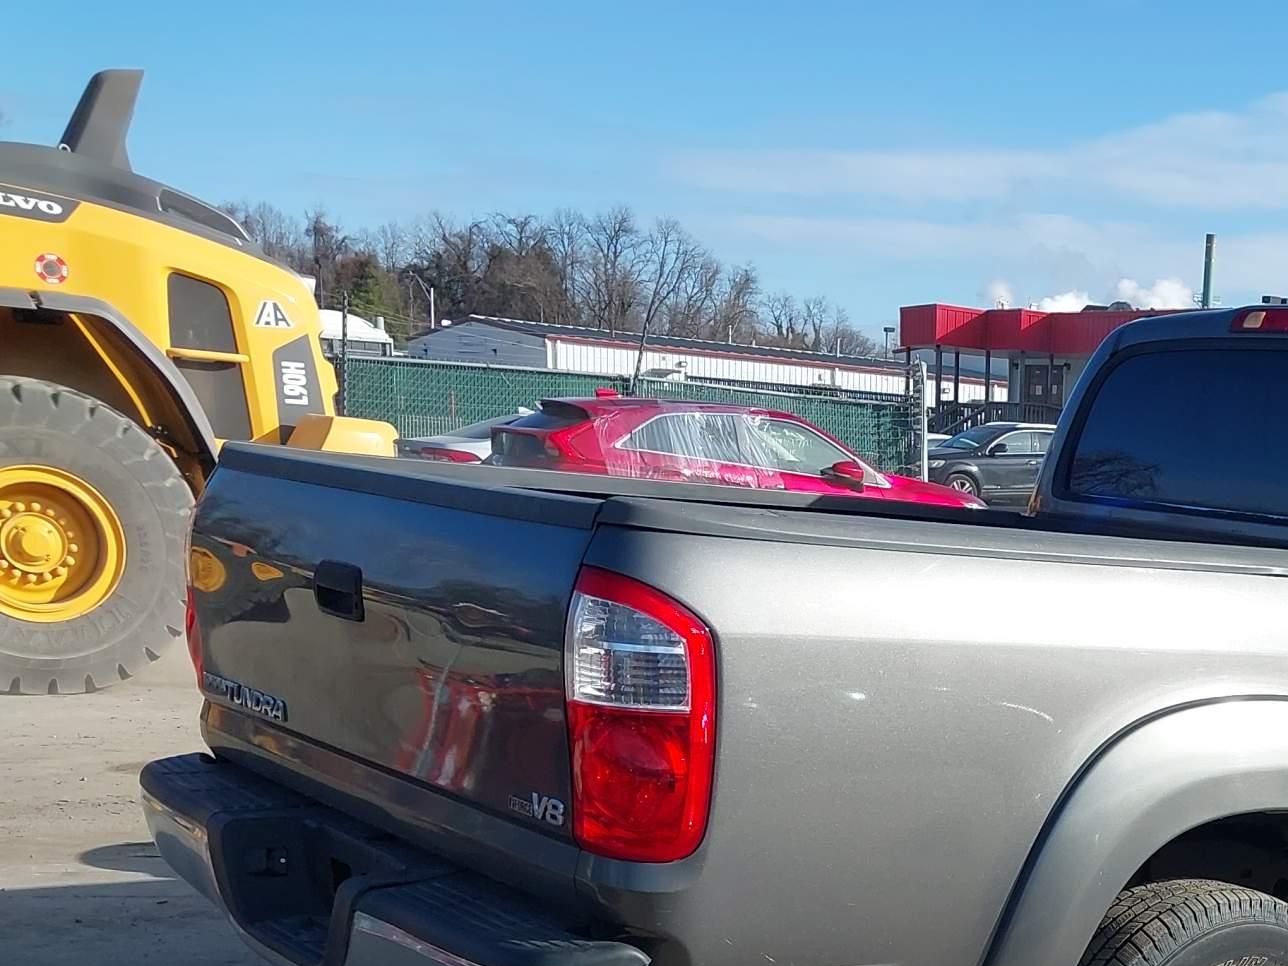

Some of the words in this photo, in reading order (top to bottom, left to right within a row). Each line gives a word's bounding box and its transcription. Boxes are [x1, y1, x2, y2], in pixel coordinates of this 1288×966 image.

[0, 192, 63, 215] LVO
[283, 360, 309, 406] L90H
[223, 679, 286, 722] TUNDRA
[532, 791, 565, 826] V8
